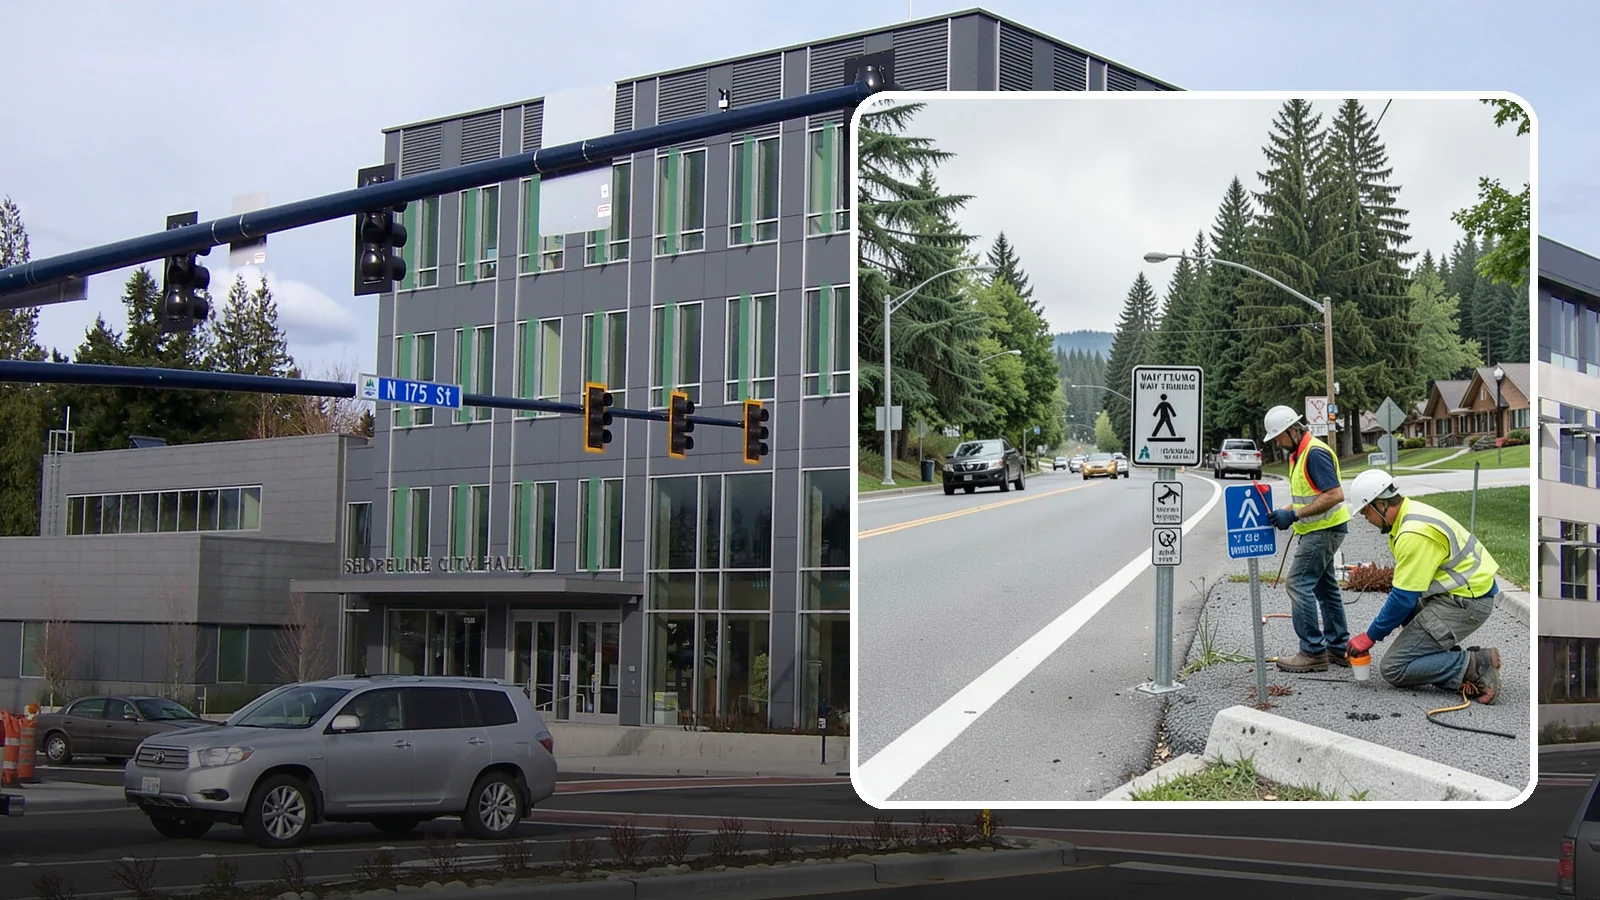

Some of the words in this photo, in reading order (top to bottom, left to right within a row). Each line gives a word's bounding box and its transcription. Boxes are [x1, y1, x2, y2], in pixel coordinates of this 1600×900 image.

[387, 380, 396, 400] N
[405, 382, 428, 403] 175
[436, 386, 452, 406] St
[344, 557, 432, 574] SHORELINE
[438, 557, 476, 573] CITY
[484, 556, 525, 572] HALL
